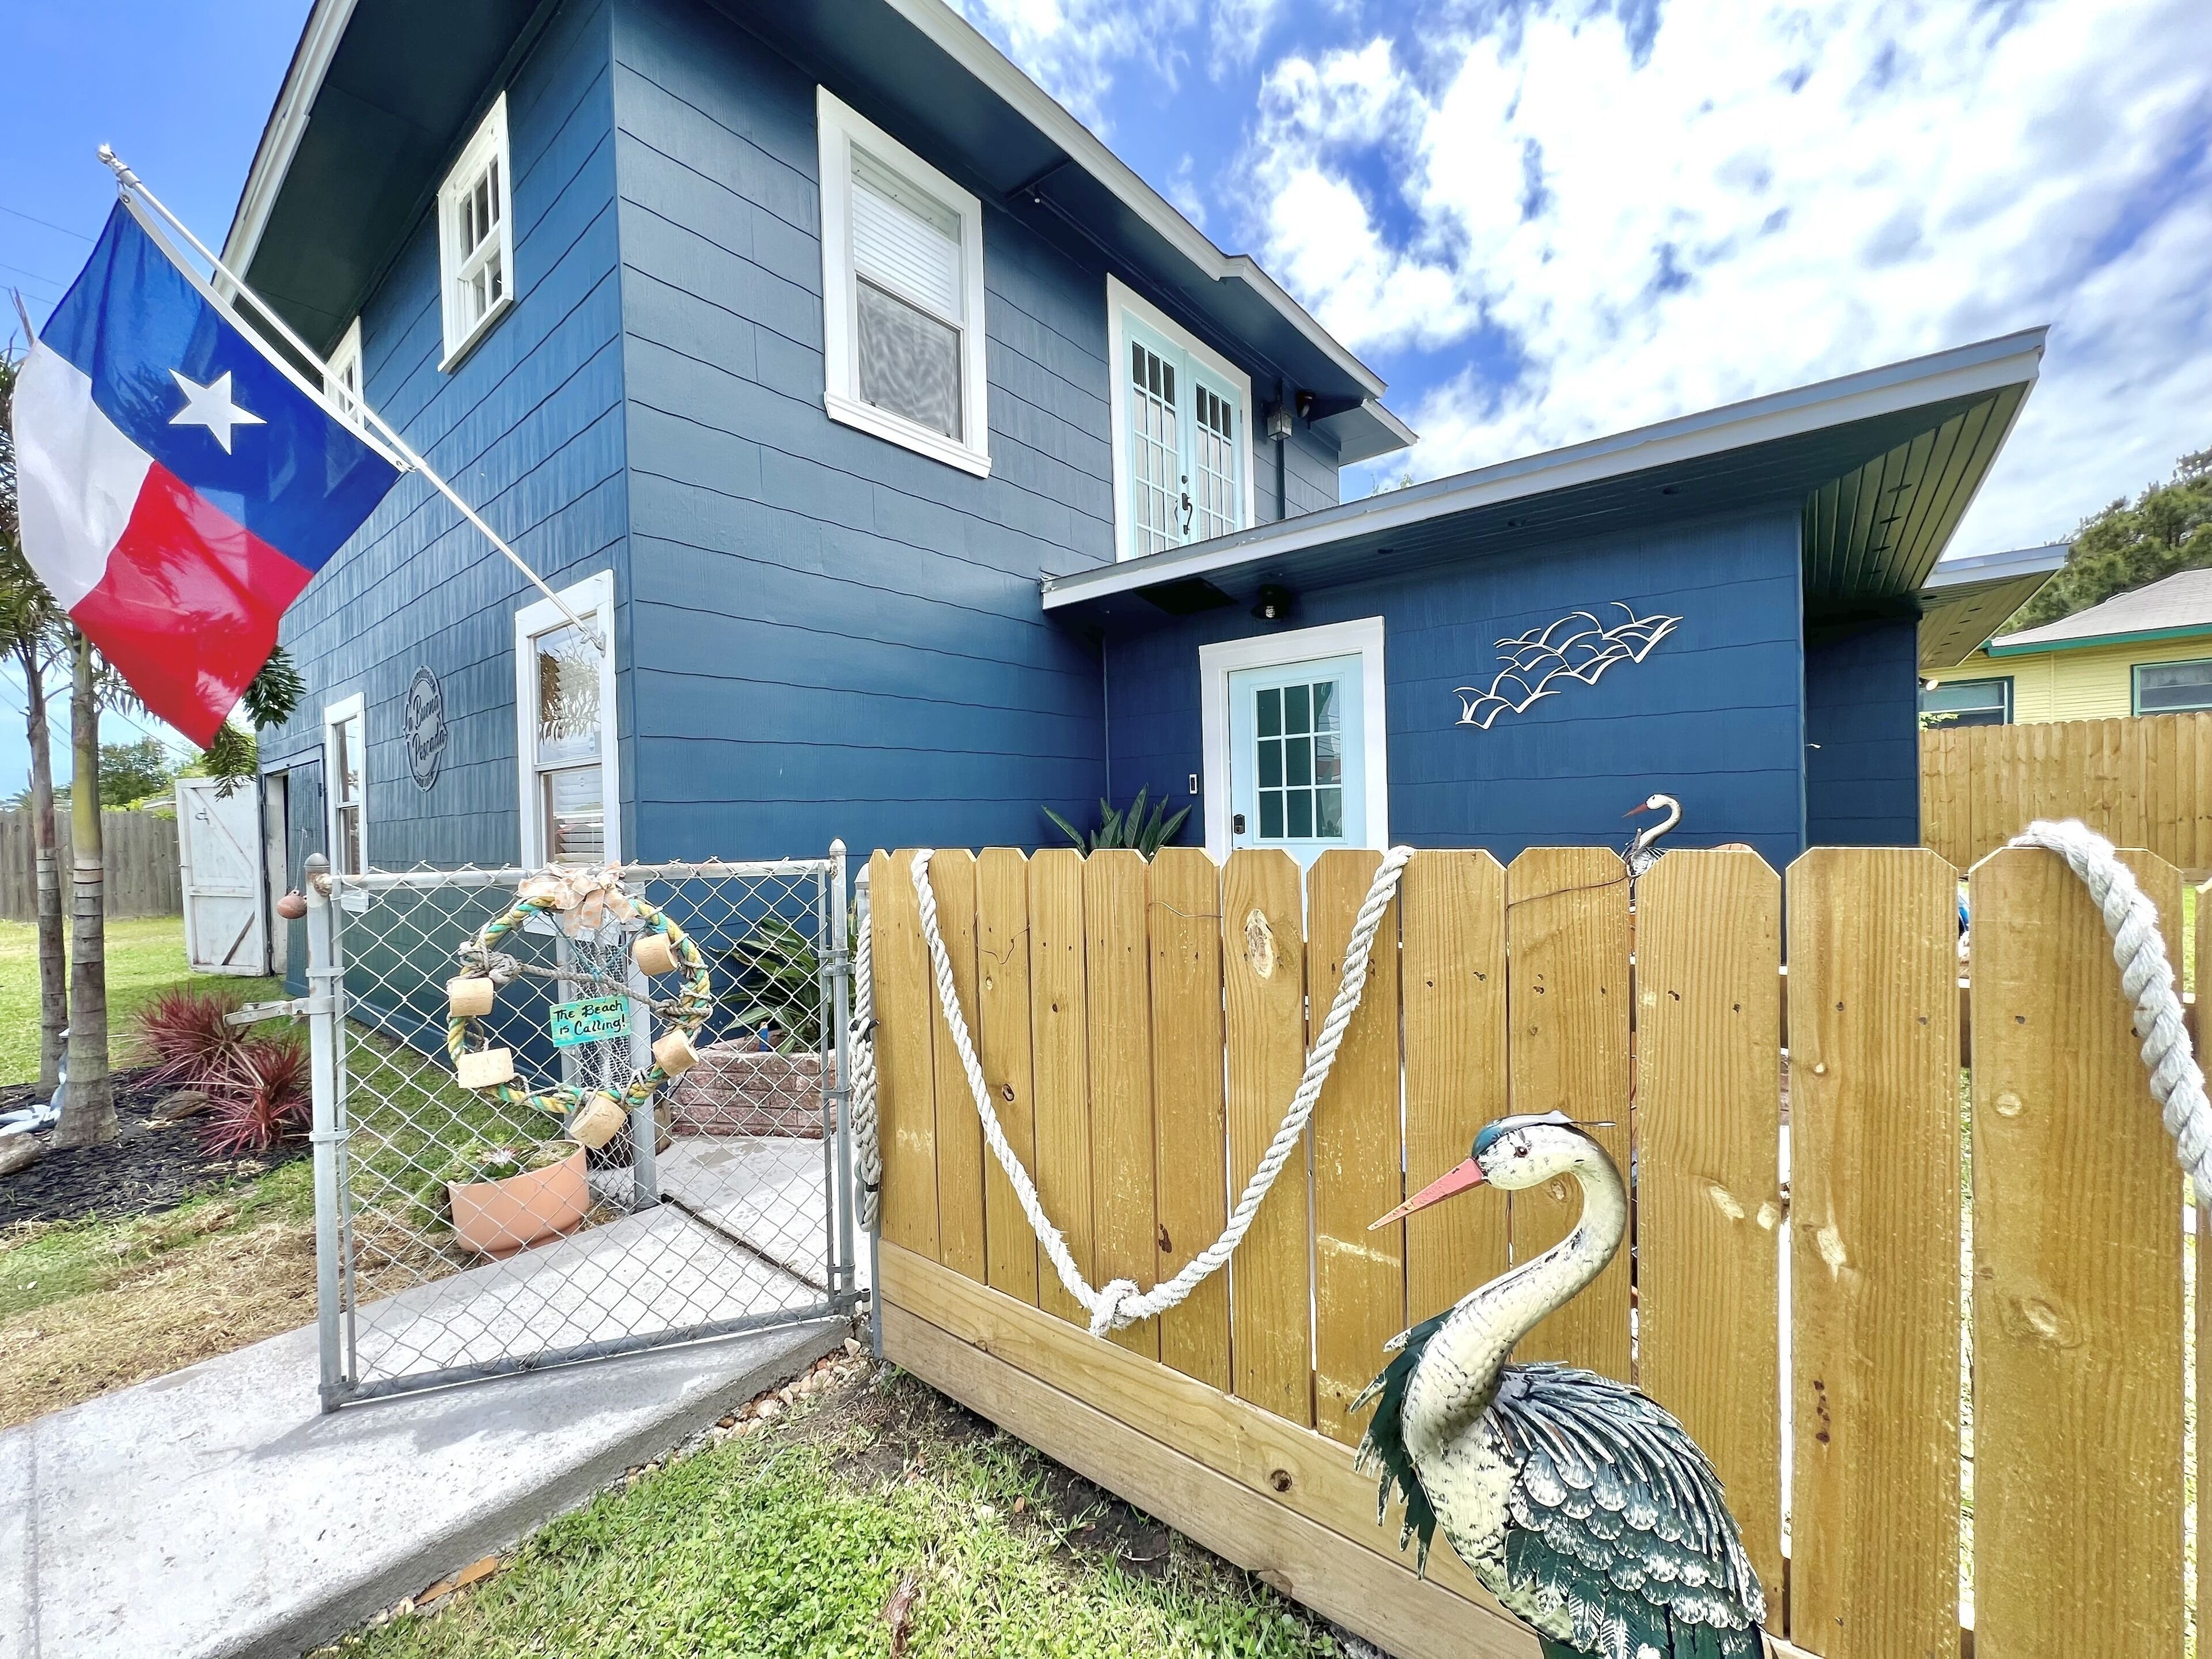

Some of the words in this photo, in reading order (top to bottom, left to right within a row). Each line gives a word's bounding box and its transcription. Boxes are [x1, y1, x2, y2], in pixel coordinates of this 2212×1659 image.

[413, 695, 440, 730] Buena
[412, 722, 448, 767] Pescada
[553, 1009, 575, 1022] The
[581, 999, 623, 1018] Beach
[559, 1024, 570, 1035] is
[574, 1013, 626, 1036] Calling!
